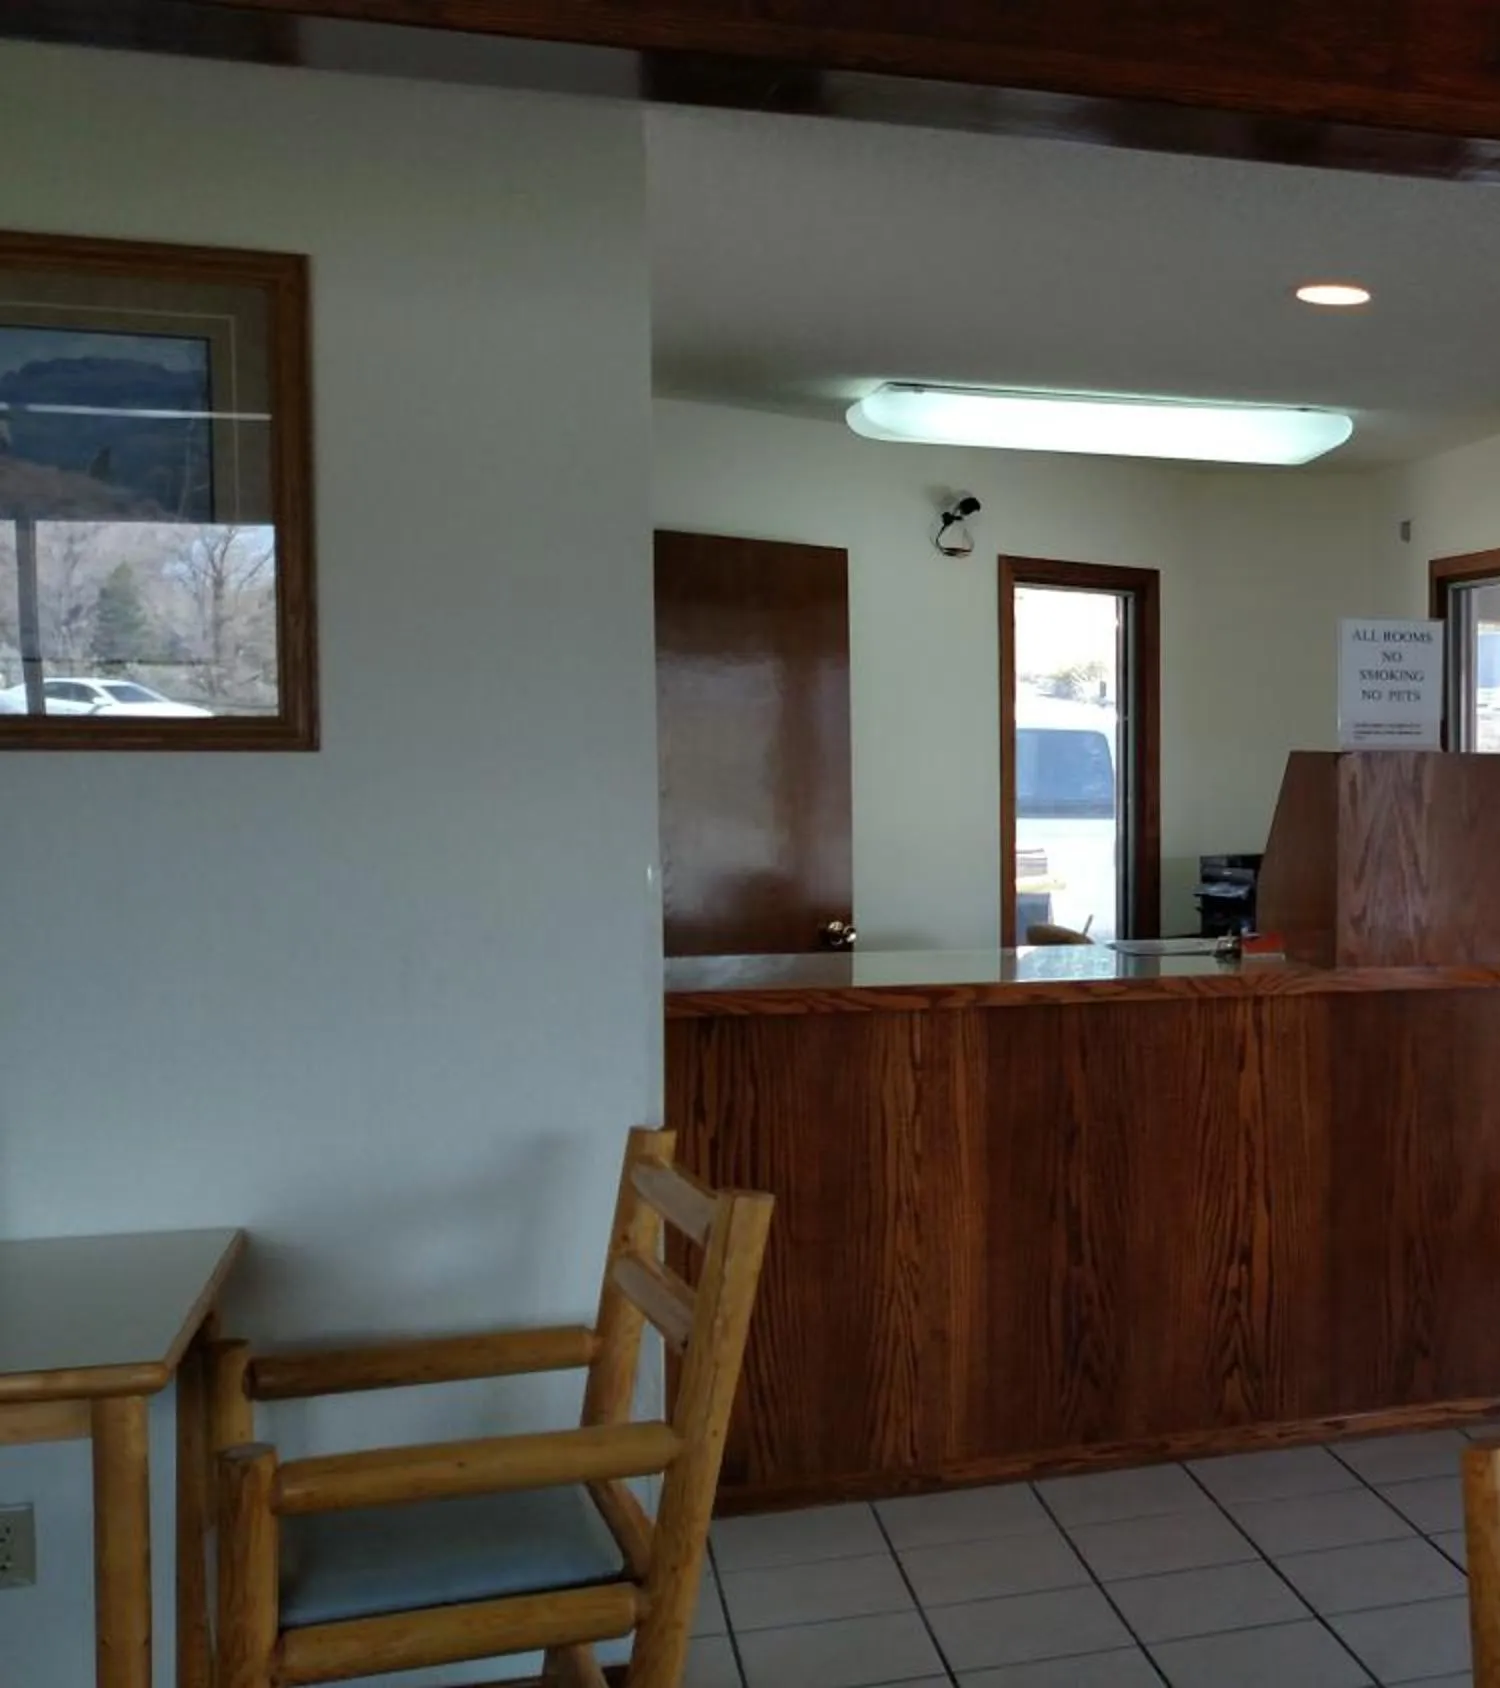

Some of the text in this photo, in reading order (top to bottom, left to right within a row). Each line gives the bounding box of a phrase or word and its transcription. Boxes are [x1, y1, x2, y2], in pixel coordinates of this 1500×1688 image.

[1352, 629, 1433, 644] ALL ROOMS
[1381, 651, 1403, 663] NO
[1359, 669, 1425, 683] SMOKING
[1361, 689, 1421, 702] NO PETS
